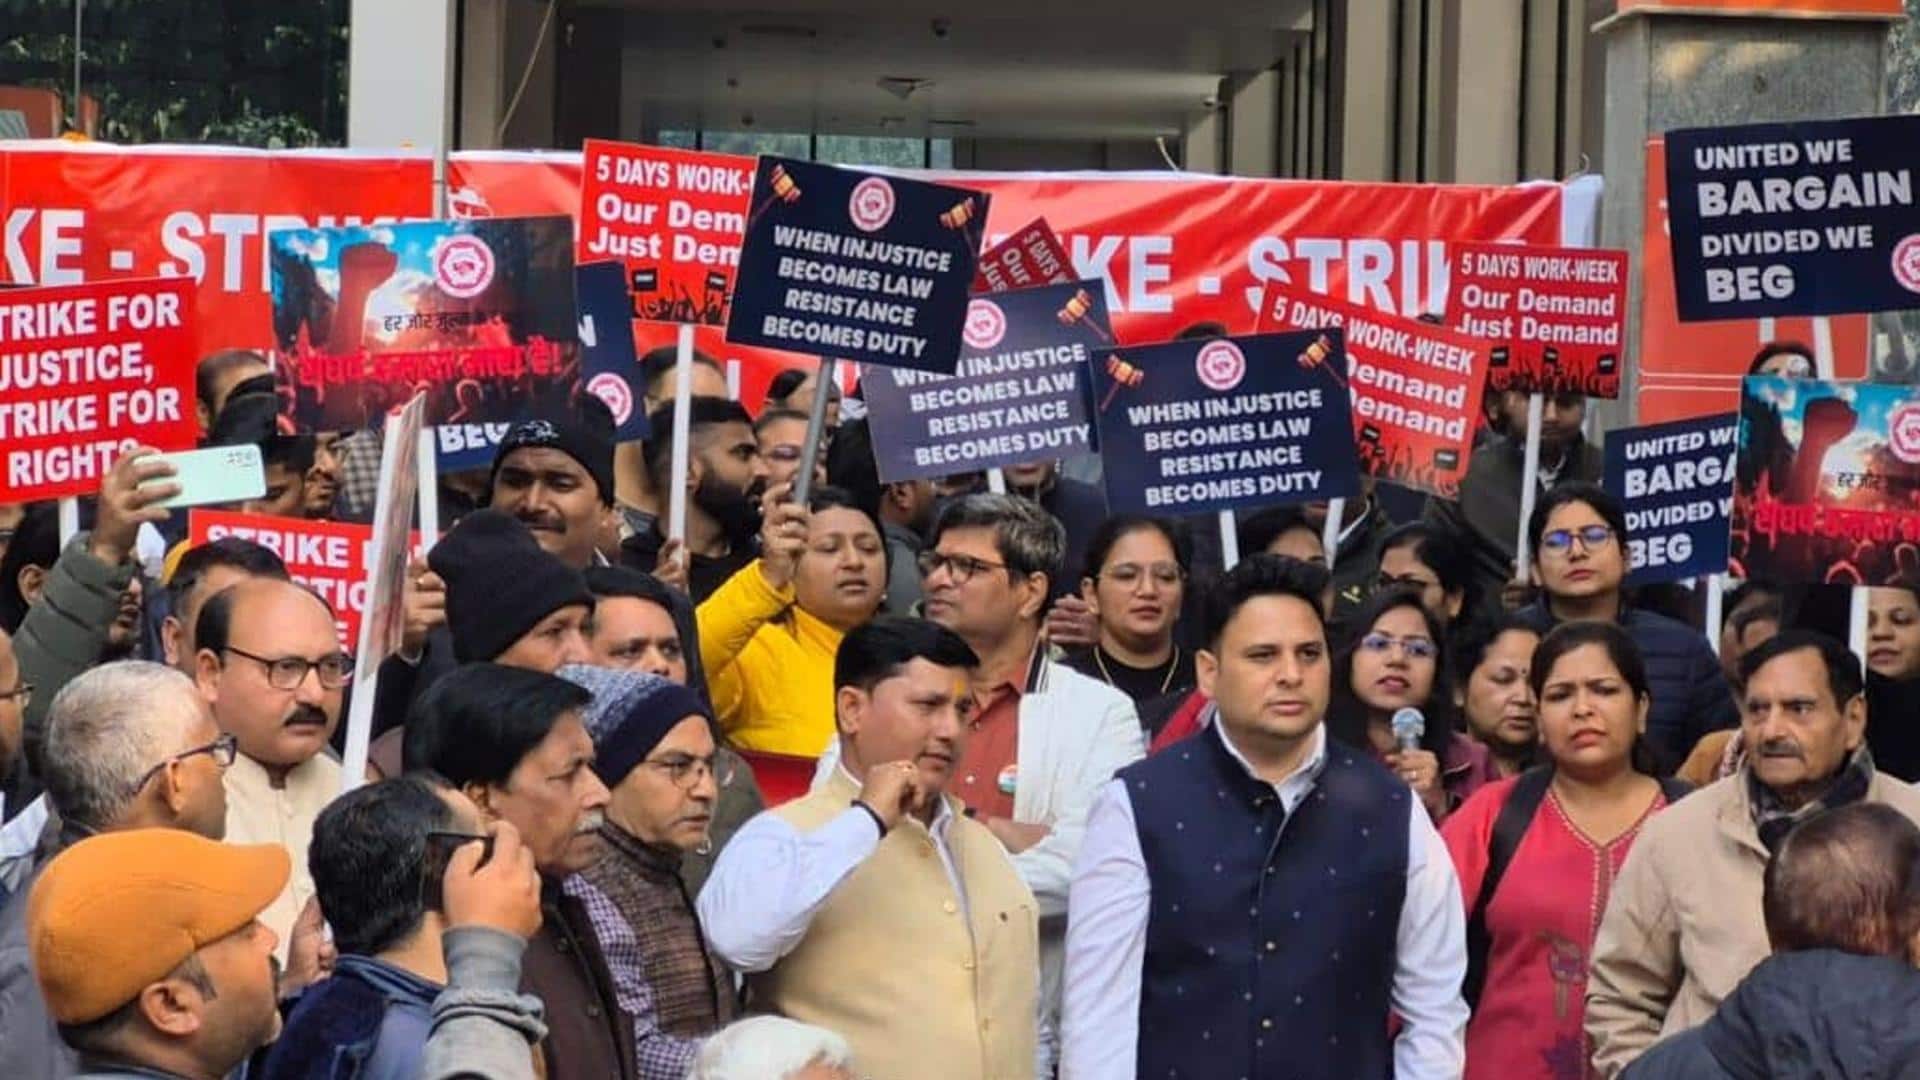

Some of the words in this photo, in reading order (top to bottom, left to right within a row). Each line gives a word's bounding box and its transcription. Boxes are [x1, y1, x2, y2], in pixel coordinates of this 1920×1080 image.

[1694, 142, 1800, 170] UNITED
[1804, 138, 1853, 164] WE
[596, 155, 611, 182] 5
[615, 157, 670, 188] DAYS
[676, 163, 754, 195] WORK-
[1697, 169, 1914, 217] BARGAIN
[597, 193, 658, 225] Our
[668, 200, 745, 233] Dem
[588, 227, 663, 259] Just
[773, 225, 840, 253] WHEN
[842, 237, 951, 272] INJUSTICE
[1701, 229, 1821, 258] DIVIDED
[1825, 225, 1874, 250] WE
[778, 256, 881, 291] BECOMES
[883, 273, 933, 299] LAW
[1002, 248, 1032, 284] Our
[1461, 252, 1473, 275] 5
[1477, 253, 1520, 279] DAYS
[1524, 256, 1619, 284] WORK-WEEK
[1705, 264, 1795, 303] BEG
[108, 293, 181, 331] FOR
[784, 289, 916, 326] RESISTANCE
[1461, 283, 1511, 310] Our
[1517, 288, 1616, 317] Demand
[762, 315, 865, 349] BECOMES
[867, 330, 927, 358] DUTY
[1272, 297, 1288, 321] 5
[1291, 301, 1343, 329] DAYS
[1350, 318, 1475, 376] WORK-WEEK
[1454, 312, 1514, 340] Just
[1520, 316, 1619, 345] Demand
[967, 343, 1086, 376] INJUSTICE
[108, 387, 181, 427] FOR
[910, 380, 1023, 412] BECOMES
[1024, 371, 1077, 396] LAW
[1128, 401, 1200, 426] WHEN
[1205, 389, 1322, 418] INJUSTICE
[928, 401, 1070, 437] RESISTANCE
[1144, 424, 1255, 451] BECOMES
[1260, 418, 1311, 440] LAW
[915, 434, 1026, 466] BECOMES
[1029, 424, 1090, 449] DUTY
[1160, 446, 1303, 477] RESISTANCE
[1625, 431, 1705, 461] UNITED
[1145, 478, 1257, 506] BECOMES
[1260, 471, 1322, 494] DUTY
[1624, 501, 1715, 532] DIVIDED
[1627, 532, 1693, 569] BEG
